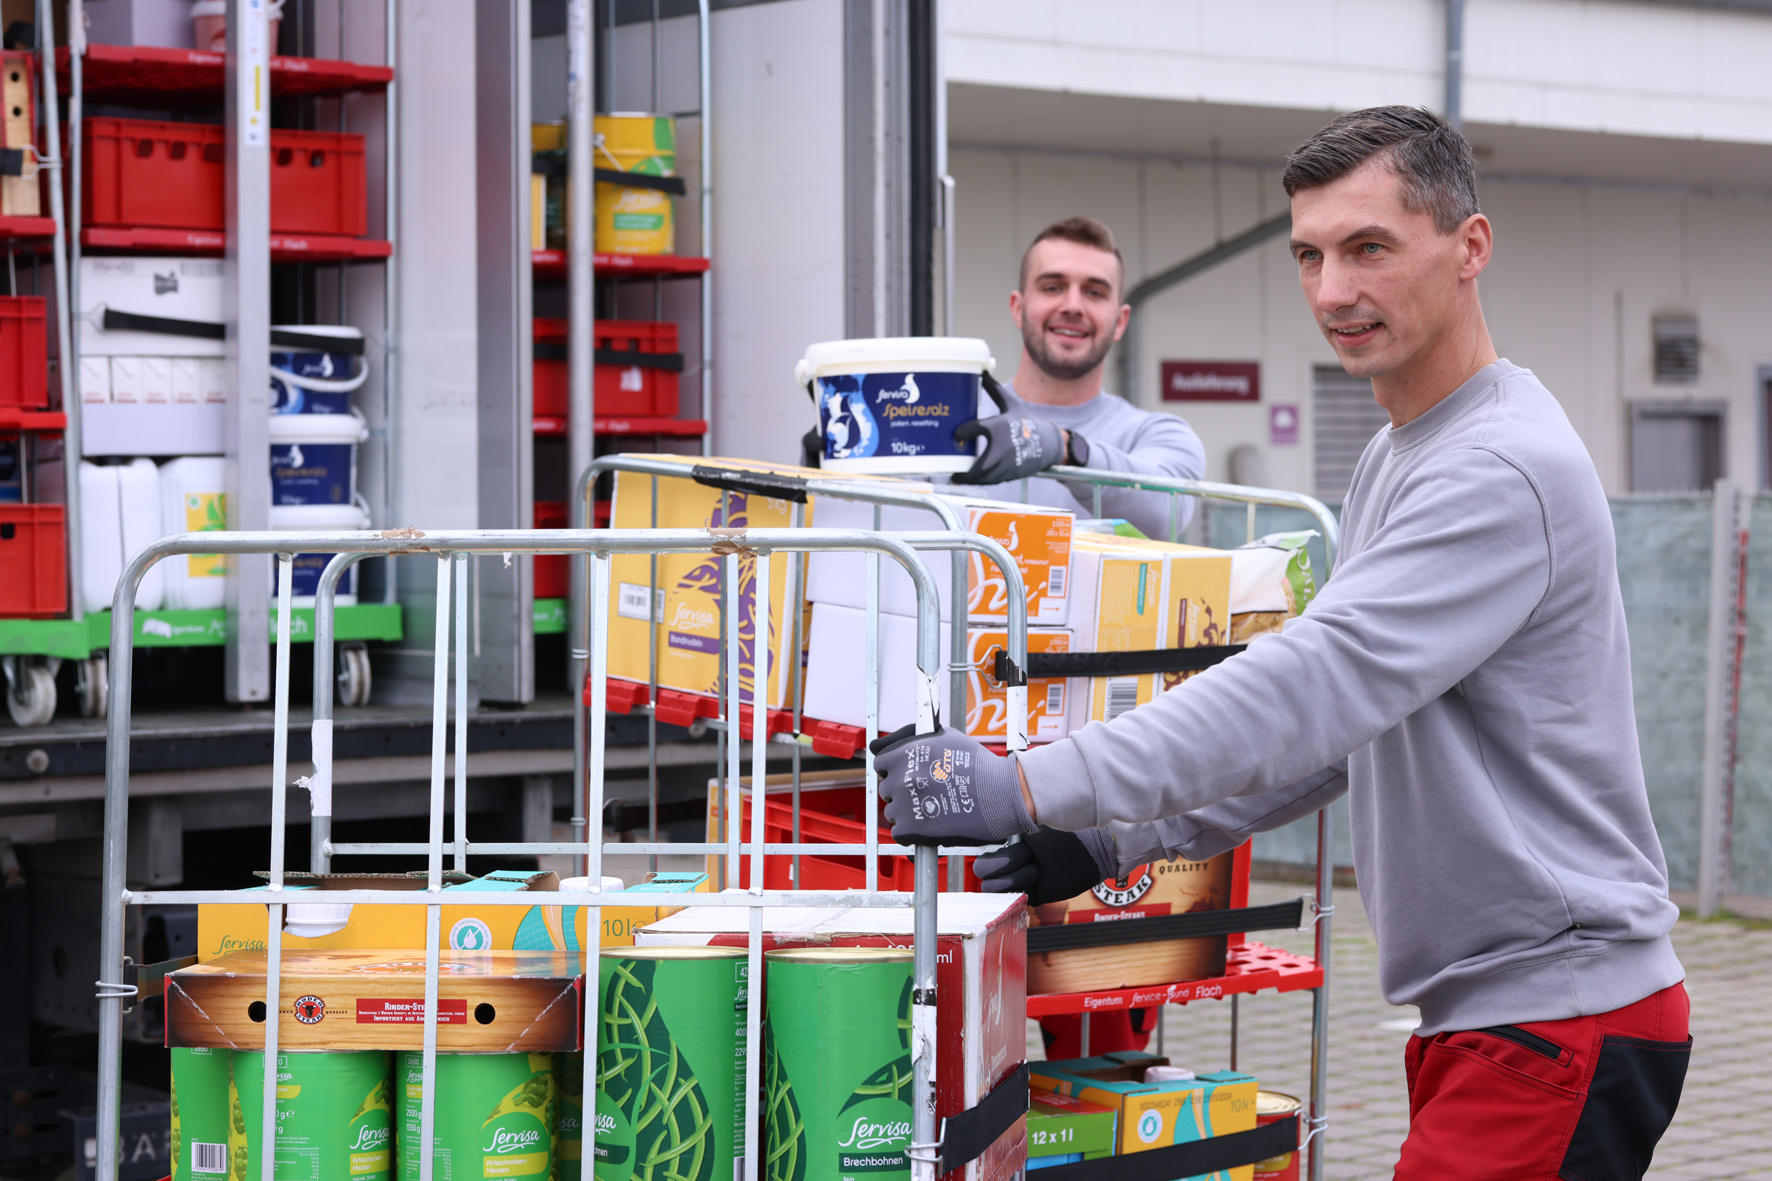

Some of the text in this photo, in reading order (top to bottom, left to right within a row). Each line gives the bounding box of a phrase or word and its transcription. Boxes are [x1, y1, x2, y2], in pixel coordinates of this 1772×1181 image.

[669, 602, 715, 630] Servisa
[1159, 862, 1209, 875] QUALITY
[1094, 876, 1151, 905] STEAK
[212, 935, 267, 954] Servisa
[296, 996, 323, 1007] RODEO
[1084, 997, 1123, 1009] Eigentum
[1196, 984, 1222, 998] Flach
[296, 1013, 323, 1024] STEAK
[349, 1124, 390, 1150] Servisa
[483, 1127, 540, 1153] Servisa
[838, 1116, 911, 1149] Servisa
[1032, 1131, 1047, 1145] 12
[1049, 1133, 1057, 1143] x
[486, 1158, 528, 1166] Artischocken-
[843, 1156, 903, 1167] Brechbohnen
